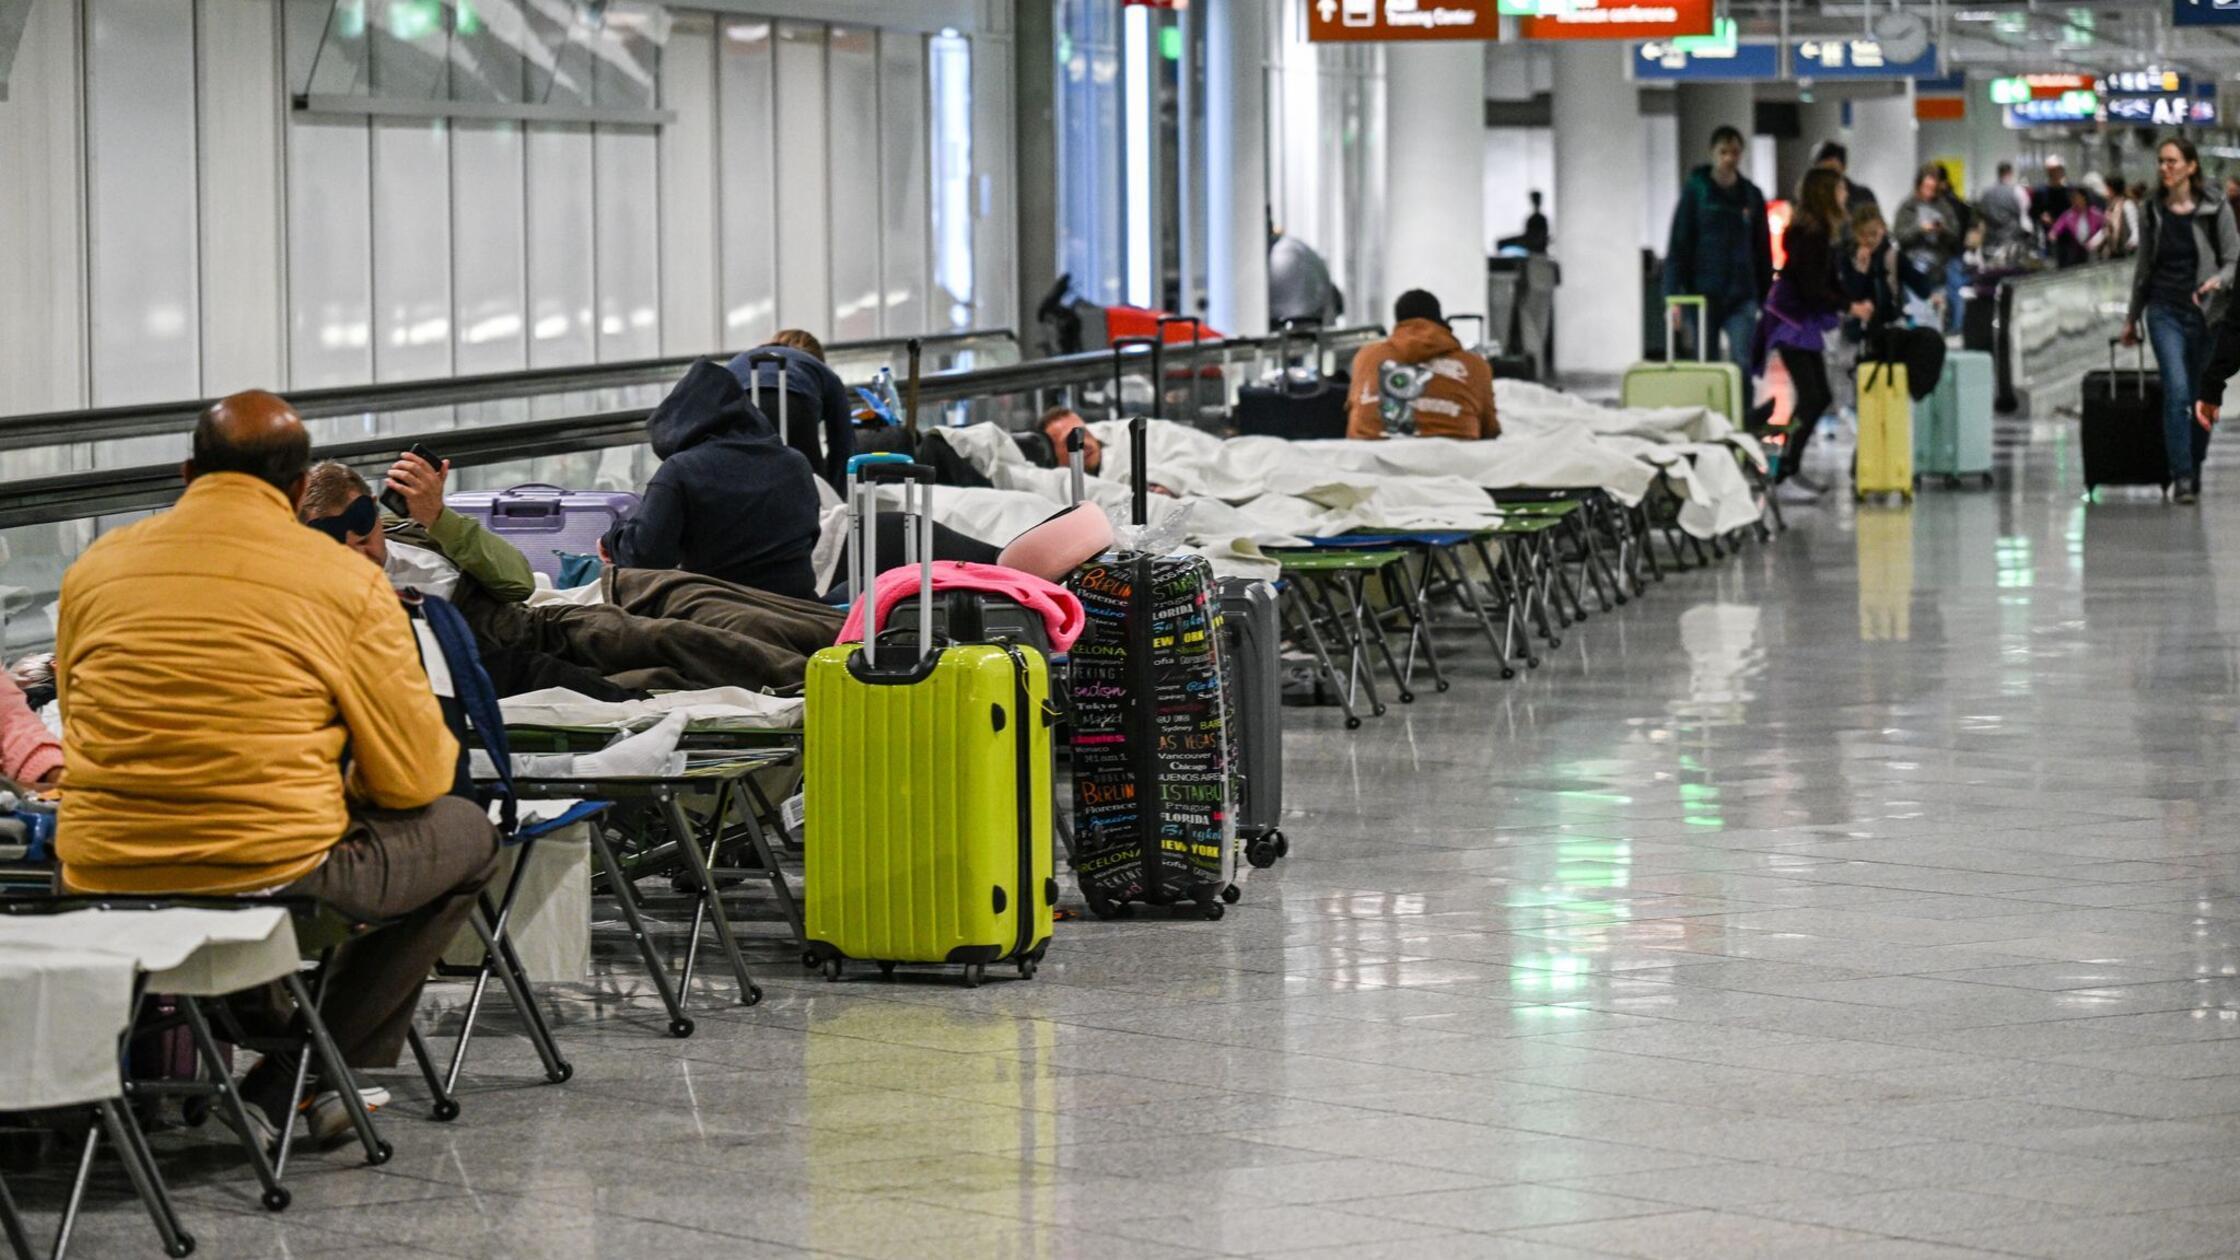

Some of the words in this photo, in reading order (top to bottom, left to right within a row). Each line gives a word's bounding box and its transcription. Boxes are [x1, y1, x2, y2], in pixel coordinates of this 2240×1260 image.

[1157, 752, 1212, 760] Vancouver
[1169, 761, 1208, 771] Chicago
[1165, 801, 1211, 813] Prague
[1191, 842, 1219, 858] YORK
